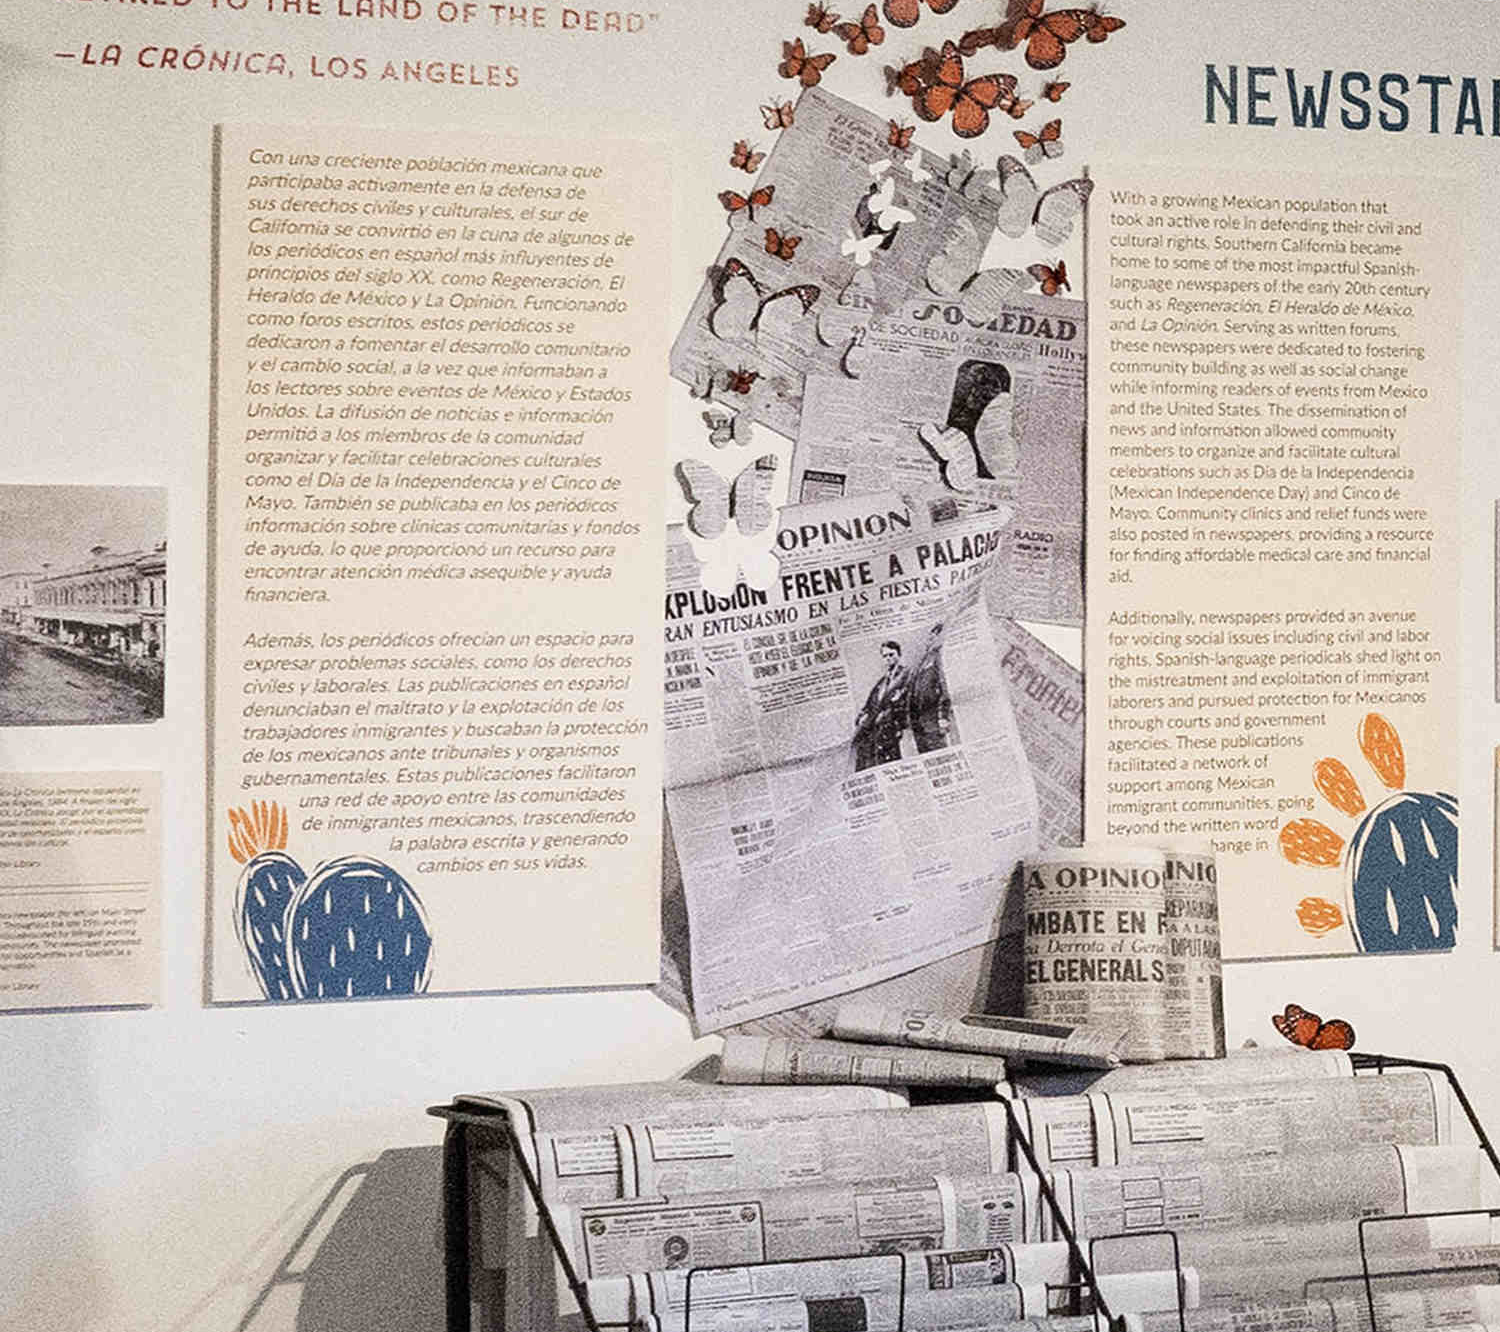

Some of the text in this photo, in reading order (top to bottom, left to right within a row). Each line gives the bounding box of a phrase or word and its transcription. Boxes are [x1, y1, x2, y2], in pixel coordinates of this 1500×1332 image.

[436, 0, 477, 24] OF
[490, 5, 548, 32] THE
[560, 6, 660, 35] DEAD”
[136, 44, 294, 78] CRÓNICA,
[310, 55, 368, 80] LOS
[380, 60, 519, 89] ANGELES
[248, 147, 603, 181] Con una creciente población mexicana que
[1110, 190, 1388, 215] With a growing Mexican population that
[890, 324, 960, 343] SOCIEDAD
[776, 507, 914, 552] OPINION
[1013, 528, 1054, 544] RADIO
[781, 561, 875, 602] FRENTE
[888, 553, 904, 578] A
[702, 606, 799, 638] ENTUSIASMO
[808, 601, 830, 619] EN
[839, 592, 870, 612] LAS
[879, 576, 942, 602] FIESTAS
[416, 852, 588, 875] cambios en sus vidas.
[1117, 911, 1146, 934] EN
[1047, 940, 1124, 953] Derrota el
[1026, 960, 1050, 984] EL
[1052, 959, 1149, 983] GENERAL
